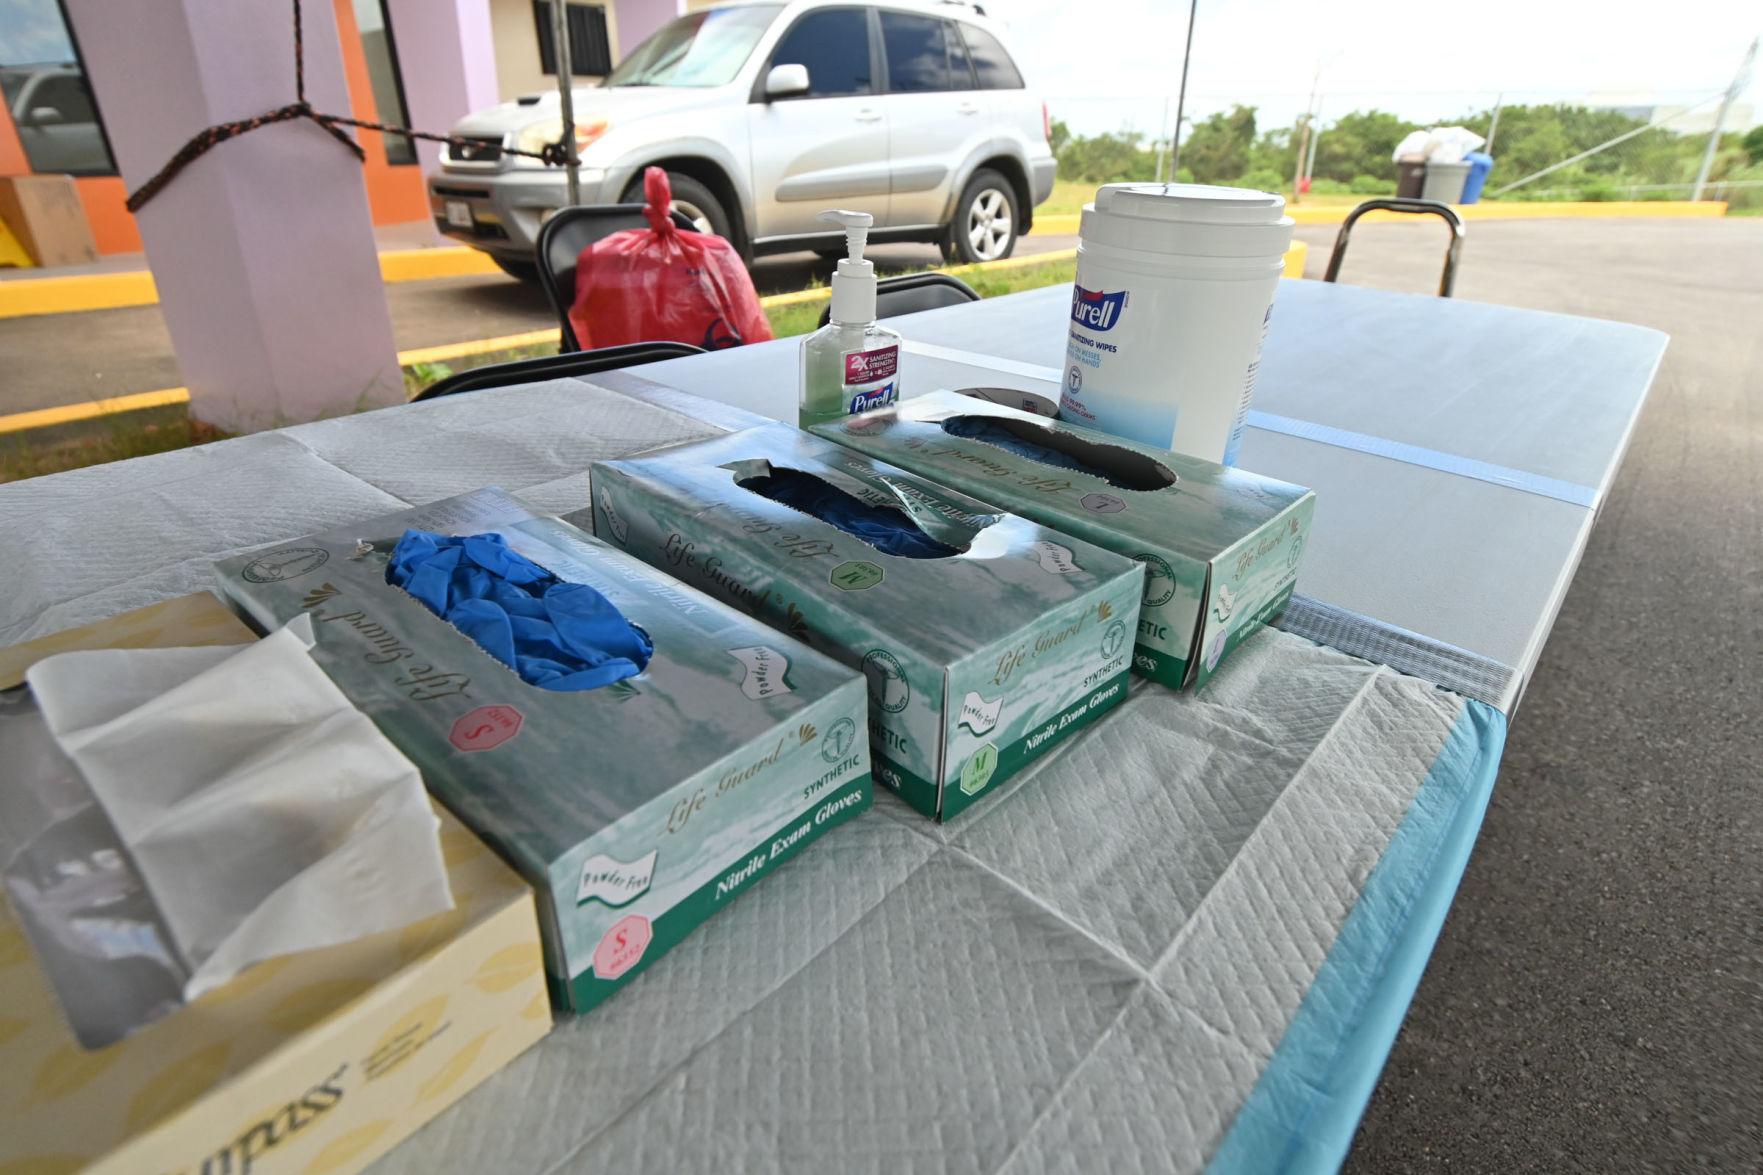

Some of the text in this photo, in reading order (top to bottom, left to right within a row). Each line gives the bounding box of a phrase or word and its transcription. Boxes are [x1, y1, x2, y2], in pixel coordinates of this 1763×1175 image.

[851, 355, 869, 371] 2X
[1096, 342, 1117, 353] WIPES
[854, 388, 890, 413] Purell
[774, 533, 839, 558] Life
[659, 533, 772, 606] Life Guard
[322, 610, 473, 700] Life Guard
[987, 645, 1025, 686] Life
[1032, 610, 1088, 658] Guard
[1083, 655, 1123, 687] SYNTHETIC
[464, 724, 495, 740] S
[1023, 683, 1120, 754] Nitrile Exam Gloves
[803, 754, 860, 799] SYNTHETIC
[972, 752, 988, 775] M
[657, 788, 707, 838] Life
[715, 738, 784, 797] Guard
[715, 788, 863, 900] Nitrile Exam Gloves
[613, 928, 628, 955] S
